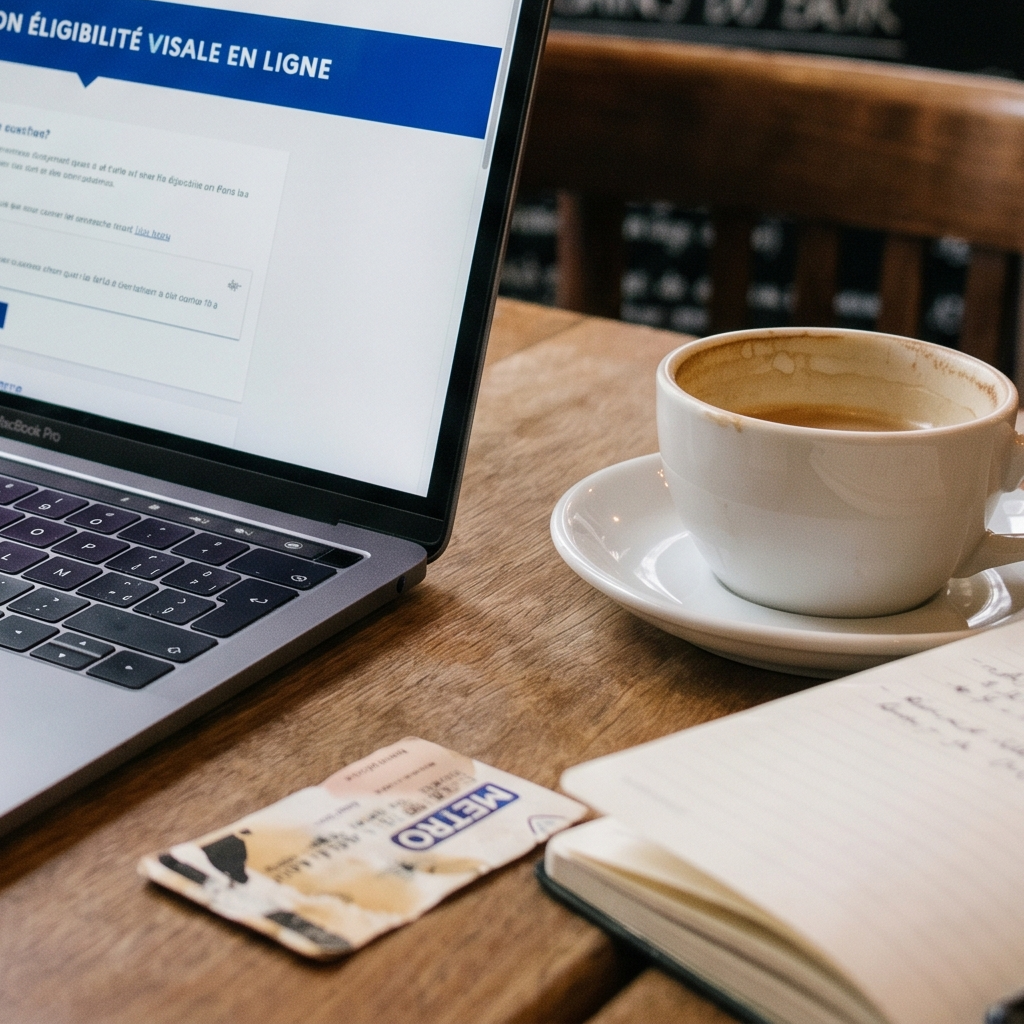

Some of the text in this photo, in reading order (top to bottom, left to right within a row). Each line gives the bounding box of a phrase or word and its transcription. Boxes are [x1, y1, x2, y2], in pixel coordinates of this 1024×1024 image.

[28, 11, 143, 51] ÉLIGIBILITÉ
[148, 33, 222, 63] VISALE
[227, 45, 257, 68] EN
[263, 50, 332, 80] LIGNE
[43, 426, 61, 443] Pro
[396, 783, 516, 851] METRO
